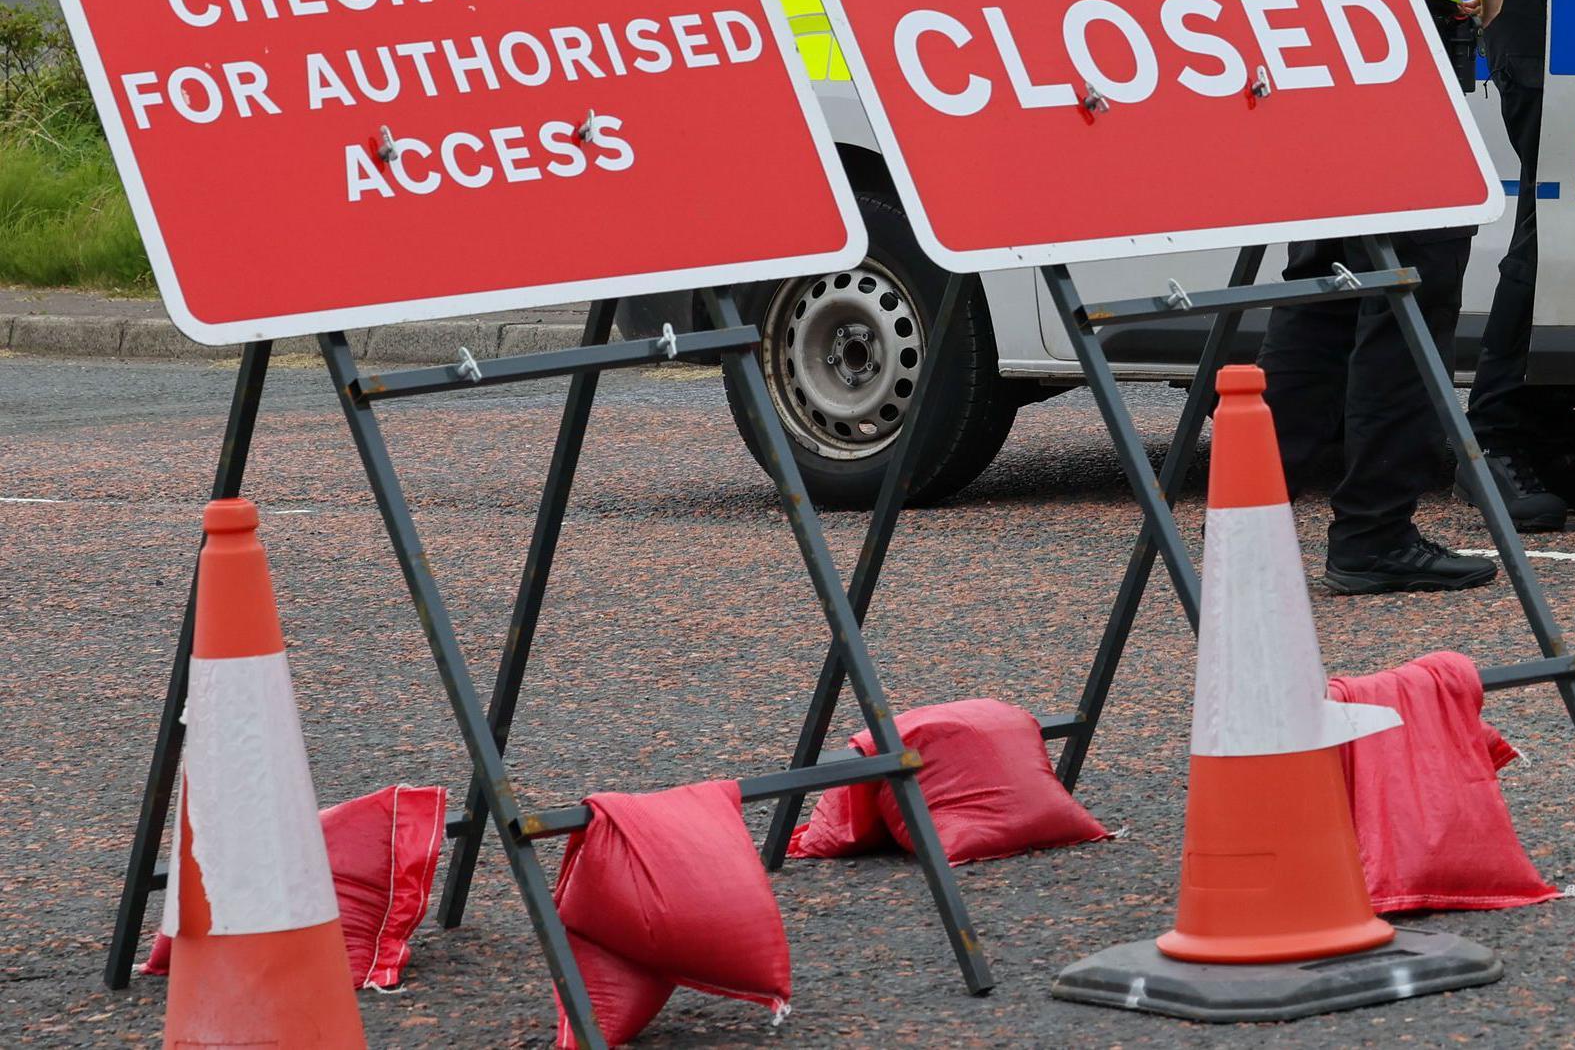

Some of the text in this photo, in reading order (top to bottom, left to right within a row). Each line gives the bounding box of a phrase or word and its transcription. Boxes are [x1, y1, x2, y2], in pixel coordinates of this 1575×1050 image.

[121, 10, 763, 129] FOR AUTHORISED
[346, 115, 635, 202] ACCESS
